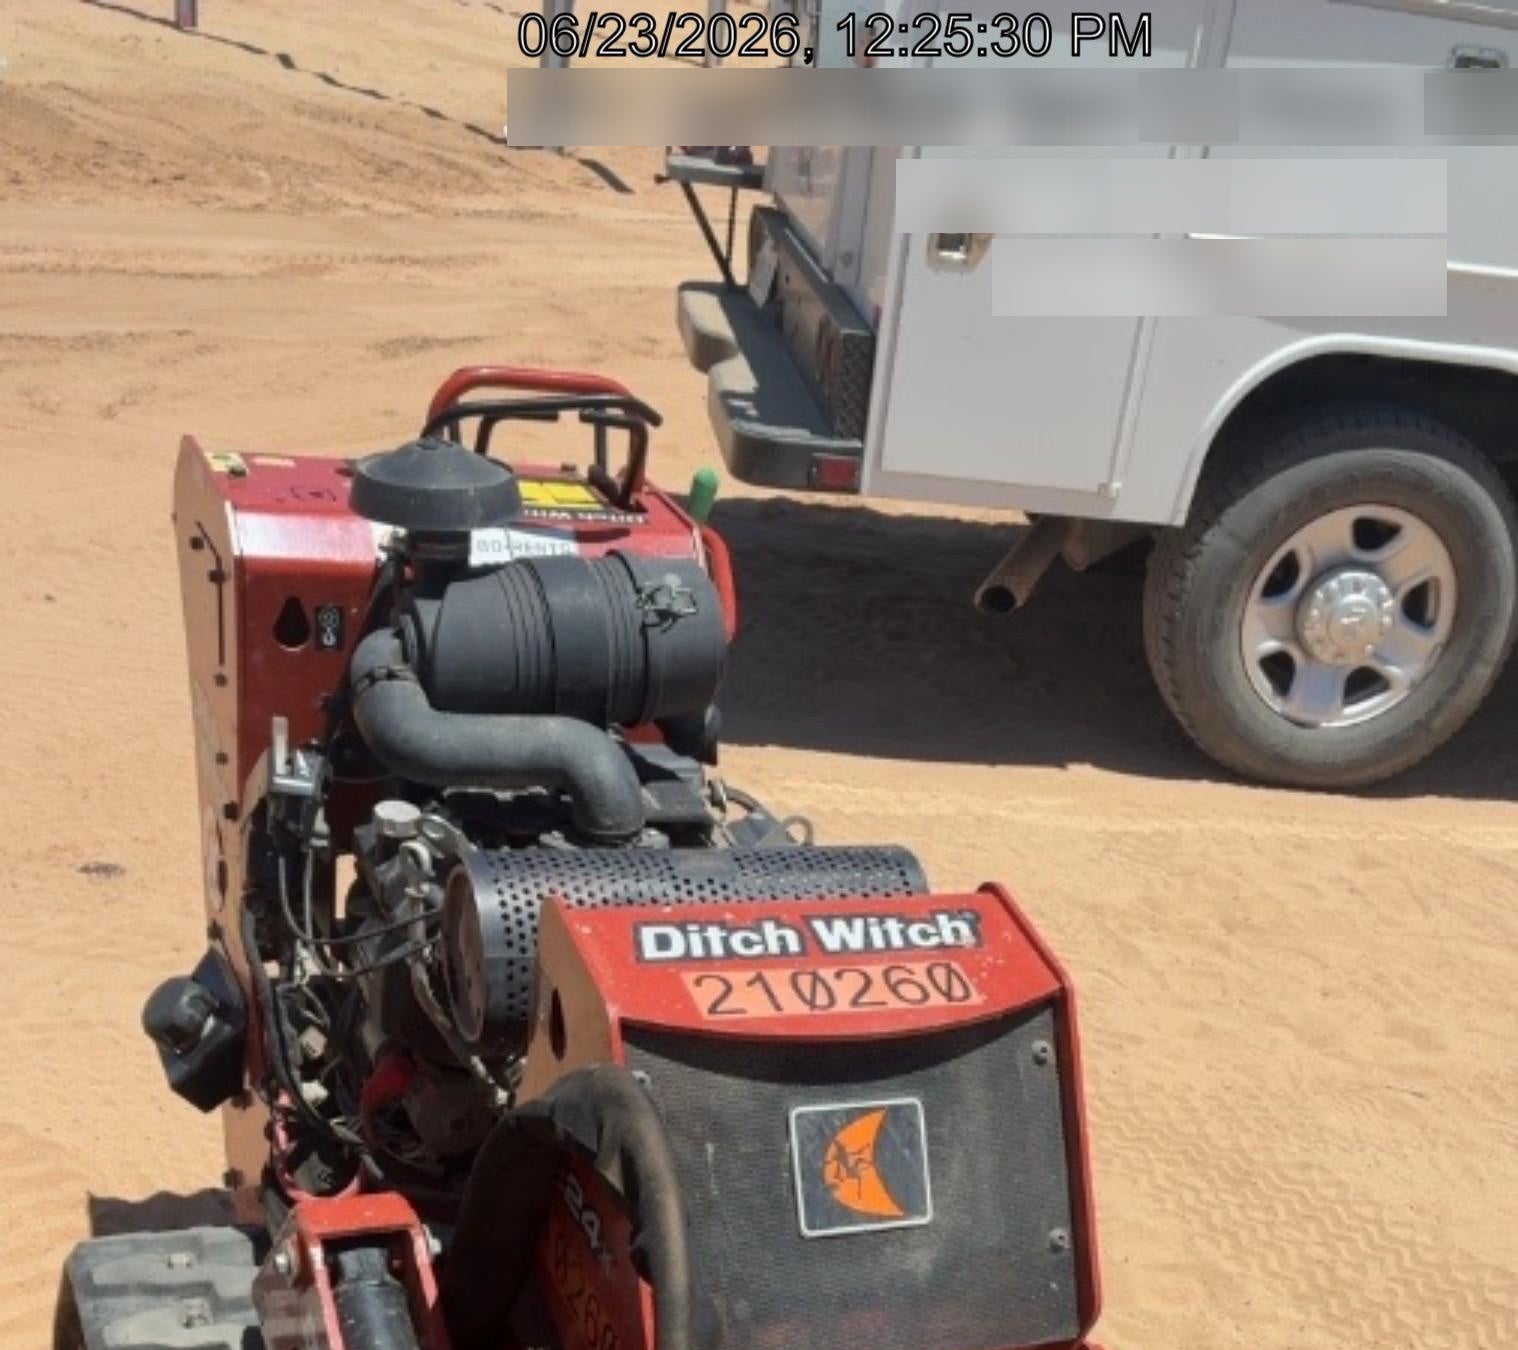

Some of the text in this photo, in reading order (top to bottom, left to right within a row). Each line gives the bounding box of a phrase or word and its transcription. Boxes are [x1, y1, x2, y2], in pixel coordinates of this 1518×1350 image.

[639, 912, 976, 961] Ditch Witch
[693, 962, 972, 1016] 210260
